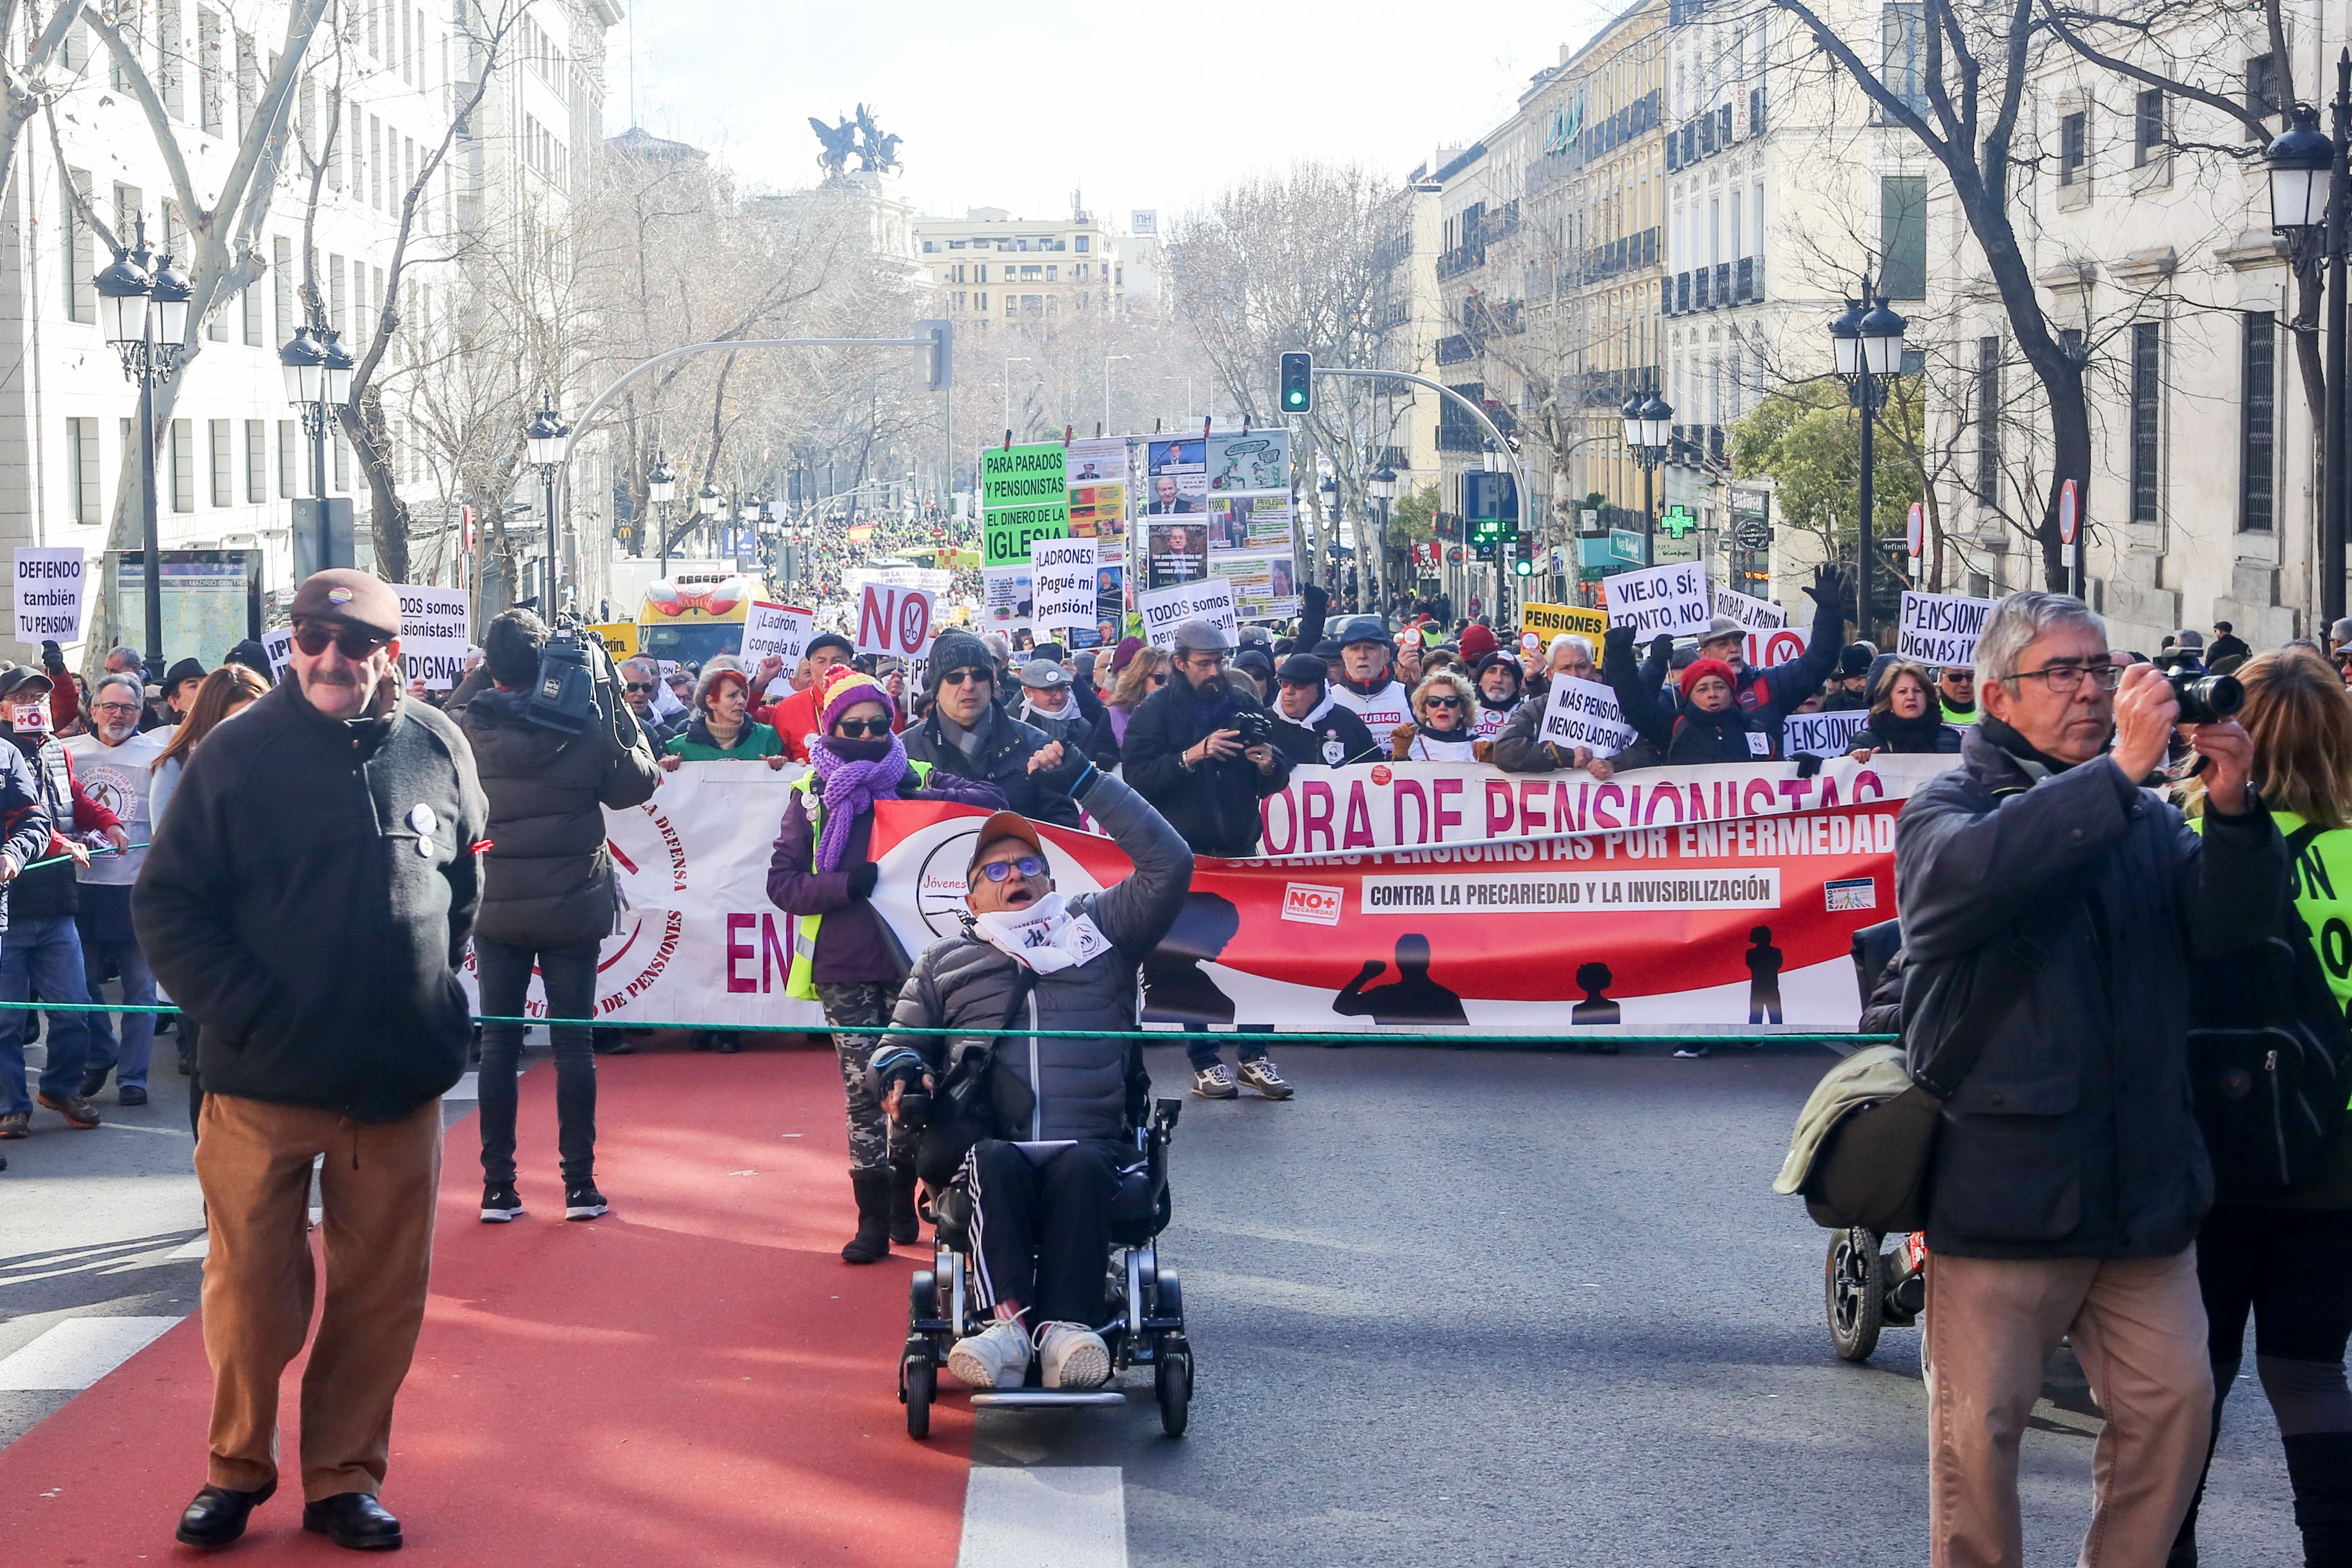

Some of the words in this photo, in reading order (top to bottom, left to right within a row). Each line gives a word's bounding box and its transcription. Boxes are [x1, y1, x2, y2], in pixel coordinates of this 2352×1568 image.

[987, 456, 1013, 474] PARA
[1016, 453, 1062, 472] PARADOS
[985, 482, 992, 498] Y
[995, 477, 1064, 498] PENSIONISTAS
[988, 514, 999, 527] EL
[1001, 510, 1035, 525] DINERO
[1038, 509, 1050, 522] DE
[1053, 508, 1065, 521] LA
[19, 561, 80, 578] DEFIENDO
[1036, 549, 1094, 572] ¡LADRONES!
[1038, 573, 1074, 597] ¡Pagué
[1079, 576, 1093, 590] mi
[1618, 578, 1673, 604] VIEJO,
[1677, 569, 1697, 596] SÍ;
[24, 589, 75, 606] también
[400, 597, 422, 613] DOS
[427, 602, 464, 616] somos
[677, 598, 713, 608] SAMUR
[859, 587, 929, 654] NO
[1038, 599, 1093, 622] pensión!
[1146, 600, 1190, 623] TODOS
[1192, 596, 1229, 612] somos
[1614, 607, 1677, 630] TONTO,
[1680, 602, 1709, 624] NO.
[1717, 593, 1744, 622] ROBAR
[1742, 606, 1754, 626] al
[1753, 606, 1780, 629] MAYOR
[20, 615, 33, 632] TU
[401, 621, 465, 638] sionistas!!!
[756, 611, 798, 635] ¡Ladrón,
[1525, 610, 1602, 634] PENSIONES
[749, 637, 787, 657] congela
[789, 640, 800, 656] tú
[745, 659, 754, 674] tu
[1559, 688, 1583, 711] MÁS
[1547, 716, 1585, 740] MENOS
[1585, 725, 1632, 750] LADRONES
[97, 768, 119, 777] MADRID
[119, 775, 130, 786] POR
[1260, 780, 1375, 856] ORA
[1393, 779, 1463, 844] DE
[1486, 770, 1884, 839] PENSIONISTAS
[1605, 826, 1668, 860] POR
[1679, 813, 1895, 858] ENFERMEDAD
[654, 816, 687, 891] DEFENSA
[923, 874, 967, 890] Jóvenes
[1371, 885, 1435, 906] CONTRA
[1441, 884, 1461, 905] LA
[1466, 883, 1580, 905] PRECARIEDAD
[1586, 883, 1596, 903] Y
[1602, 882, 1622, 903] LA
[1628, 874, 1770, 902] INVISIBILIZACIÓN
[1287, 905, 1334, 916] PRECARIEDAD
[1289, 892, 1335, 909] NO+
[602, 991, 628, 1014] DE
[625, 910, 682, 999] PENSIONES
